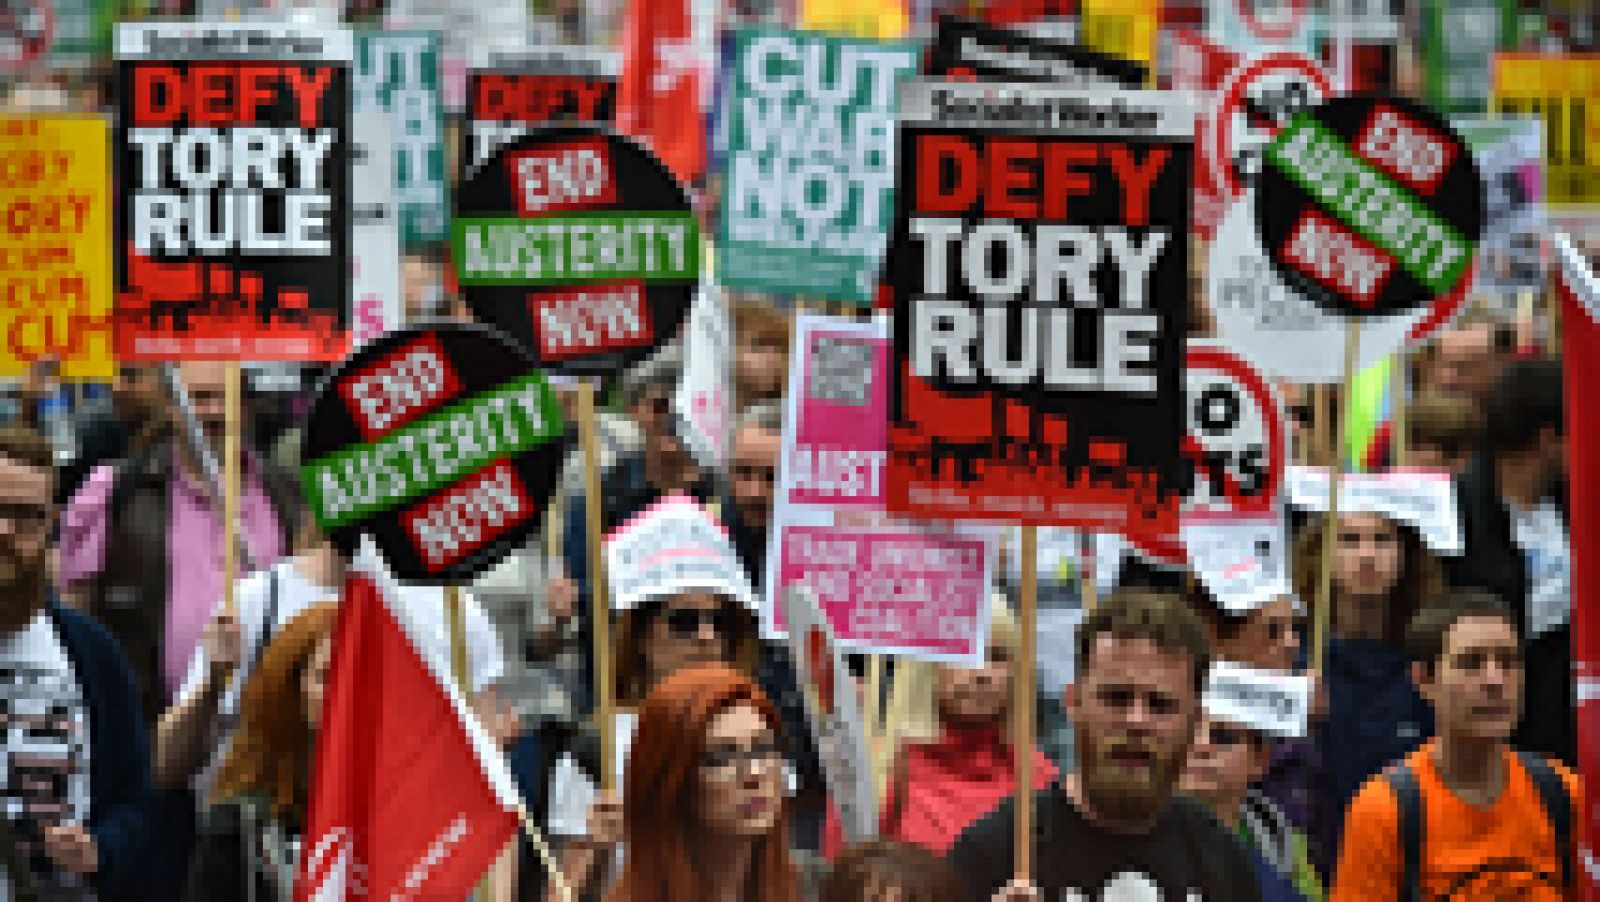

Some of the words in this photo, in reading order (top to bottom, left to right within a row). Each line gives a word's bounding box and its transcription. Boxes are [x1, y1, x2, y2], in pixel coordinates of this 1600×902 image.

[133, 65, 332, 128] DEFY
[743, 36, 914, 111] CUT
[128, 128, 336, 190] TORY
[516, 148, 609, 211] END
[916, 135, 1173, 225] DEFY
[1359, 110, 1446, 183] END
[133, 194, 332, 256] RULE
[731, 152, 893, 228] NOT
[1277, 126, 1467, 280] AUSTERITY
[464, 225, 690, 279] AUSTERITY
[908, 217, 1172, 309] TORY
[1288, 217, 1394, 298] NOW
[539, 287, 643, 351] NOW
[908, 300, 1158, 392] RULE
[352, 350, 444, 430] END
[321, 383, 546, 521] AUSTERITY
[411, 463, 520, 567] NOW
